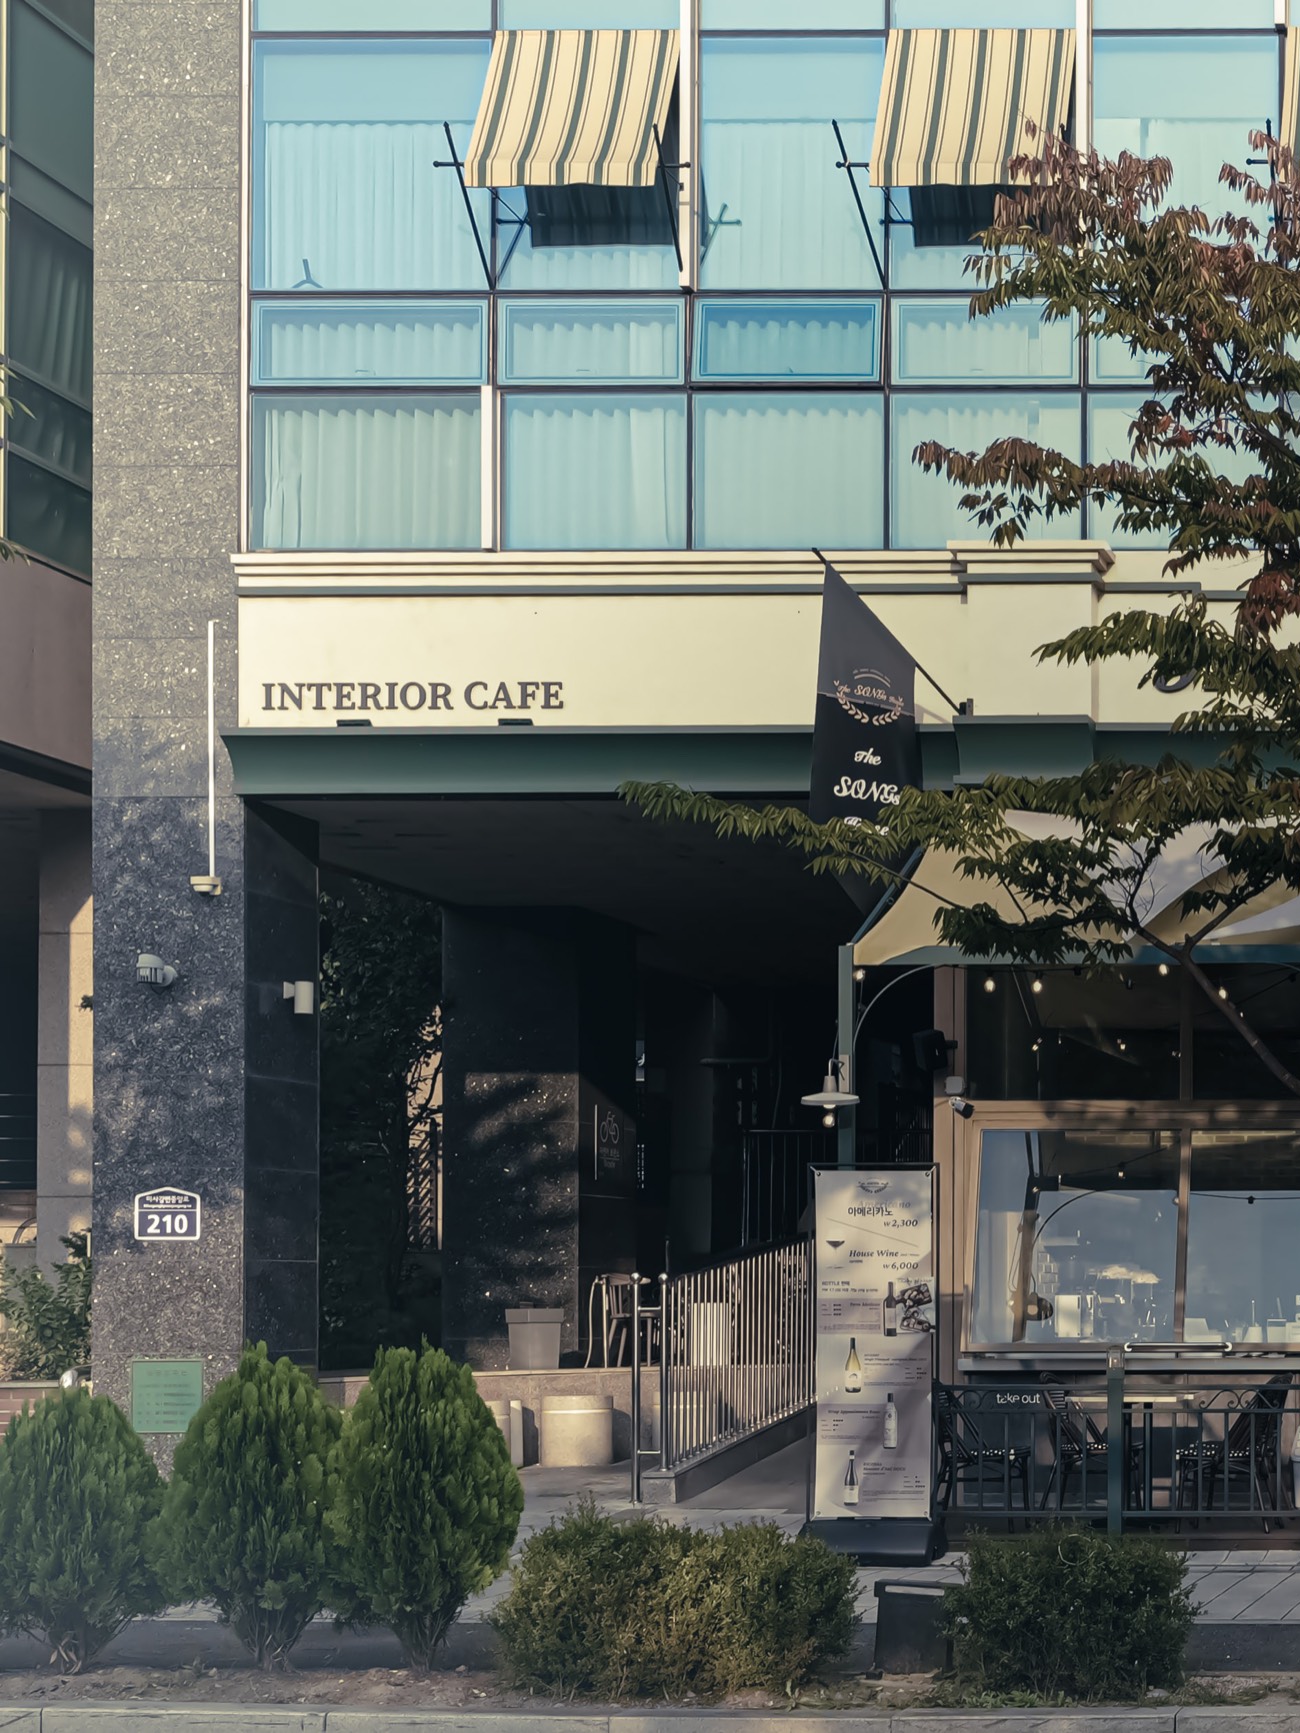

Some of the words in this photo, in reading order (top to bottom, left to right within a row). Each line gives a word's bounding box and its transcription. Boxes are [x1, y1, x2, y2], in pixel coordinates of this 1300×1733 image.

[261, 682, 454, 711] INTERIOR
[463, 681, 565, 711] CAFE
[854, 747, 882, 766] The
[833, 775, 900, 806] SONGs
[847, 1206, 894, 1217] 아메리카노
[146, 1213, 189, 1234] 210
[848, 1248, 875, 1258] House
[877, 1248, 900, 1258] Wine
[996, 1392, 1020, 1404] take
[1021, 1392, 1041, 1404] out
